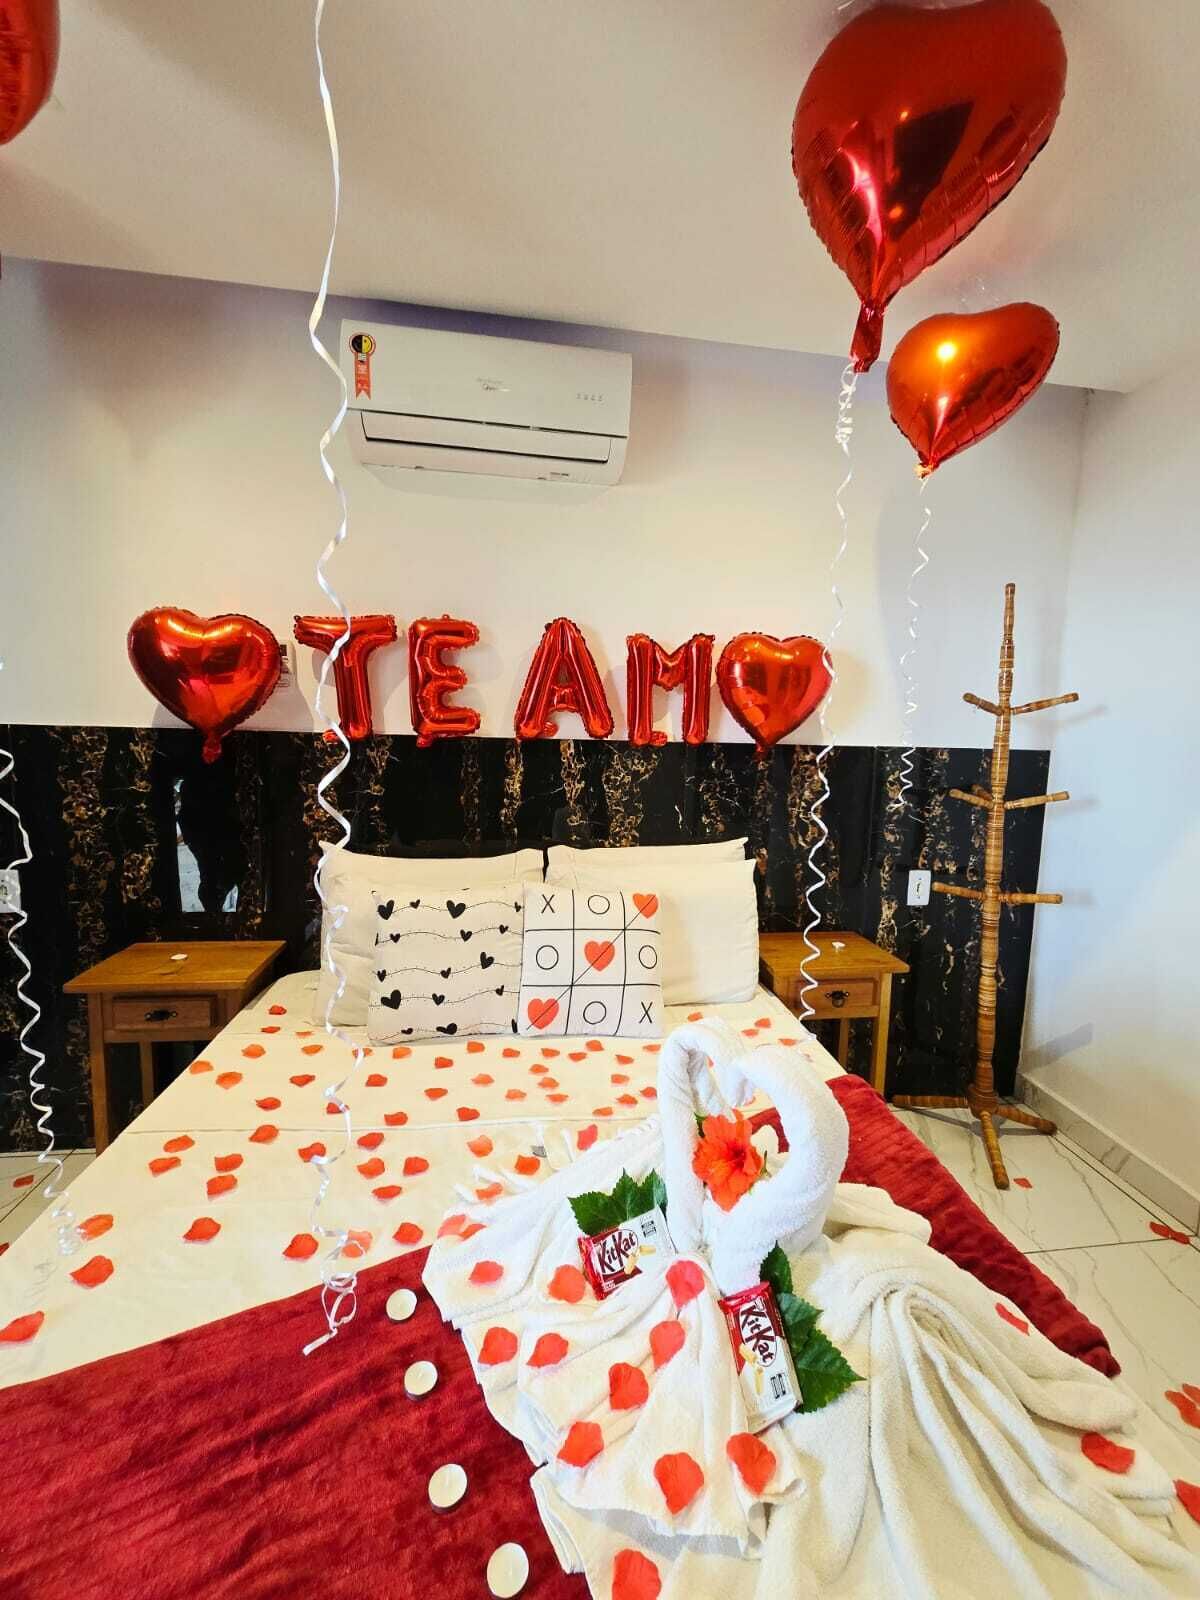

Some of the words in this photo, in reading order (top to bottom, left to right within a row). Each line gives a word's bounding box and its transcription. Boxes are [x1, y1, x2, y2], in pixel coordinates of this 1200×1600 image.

[293, 614, 481, 744] TE
[597, 1231, 637, 1274] KitKat
[740, 1304, 776, 1363] KitKat
